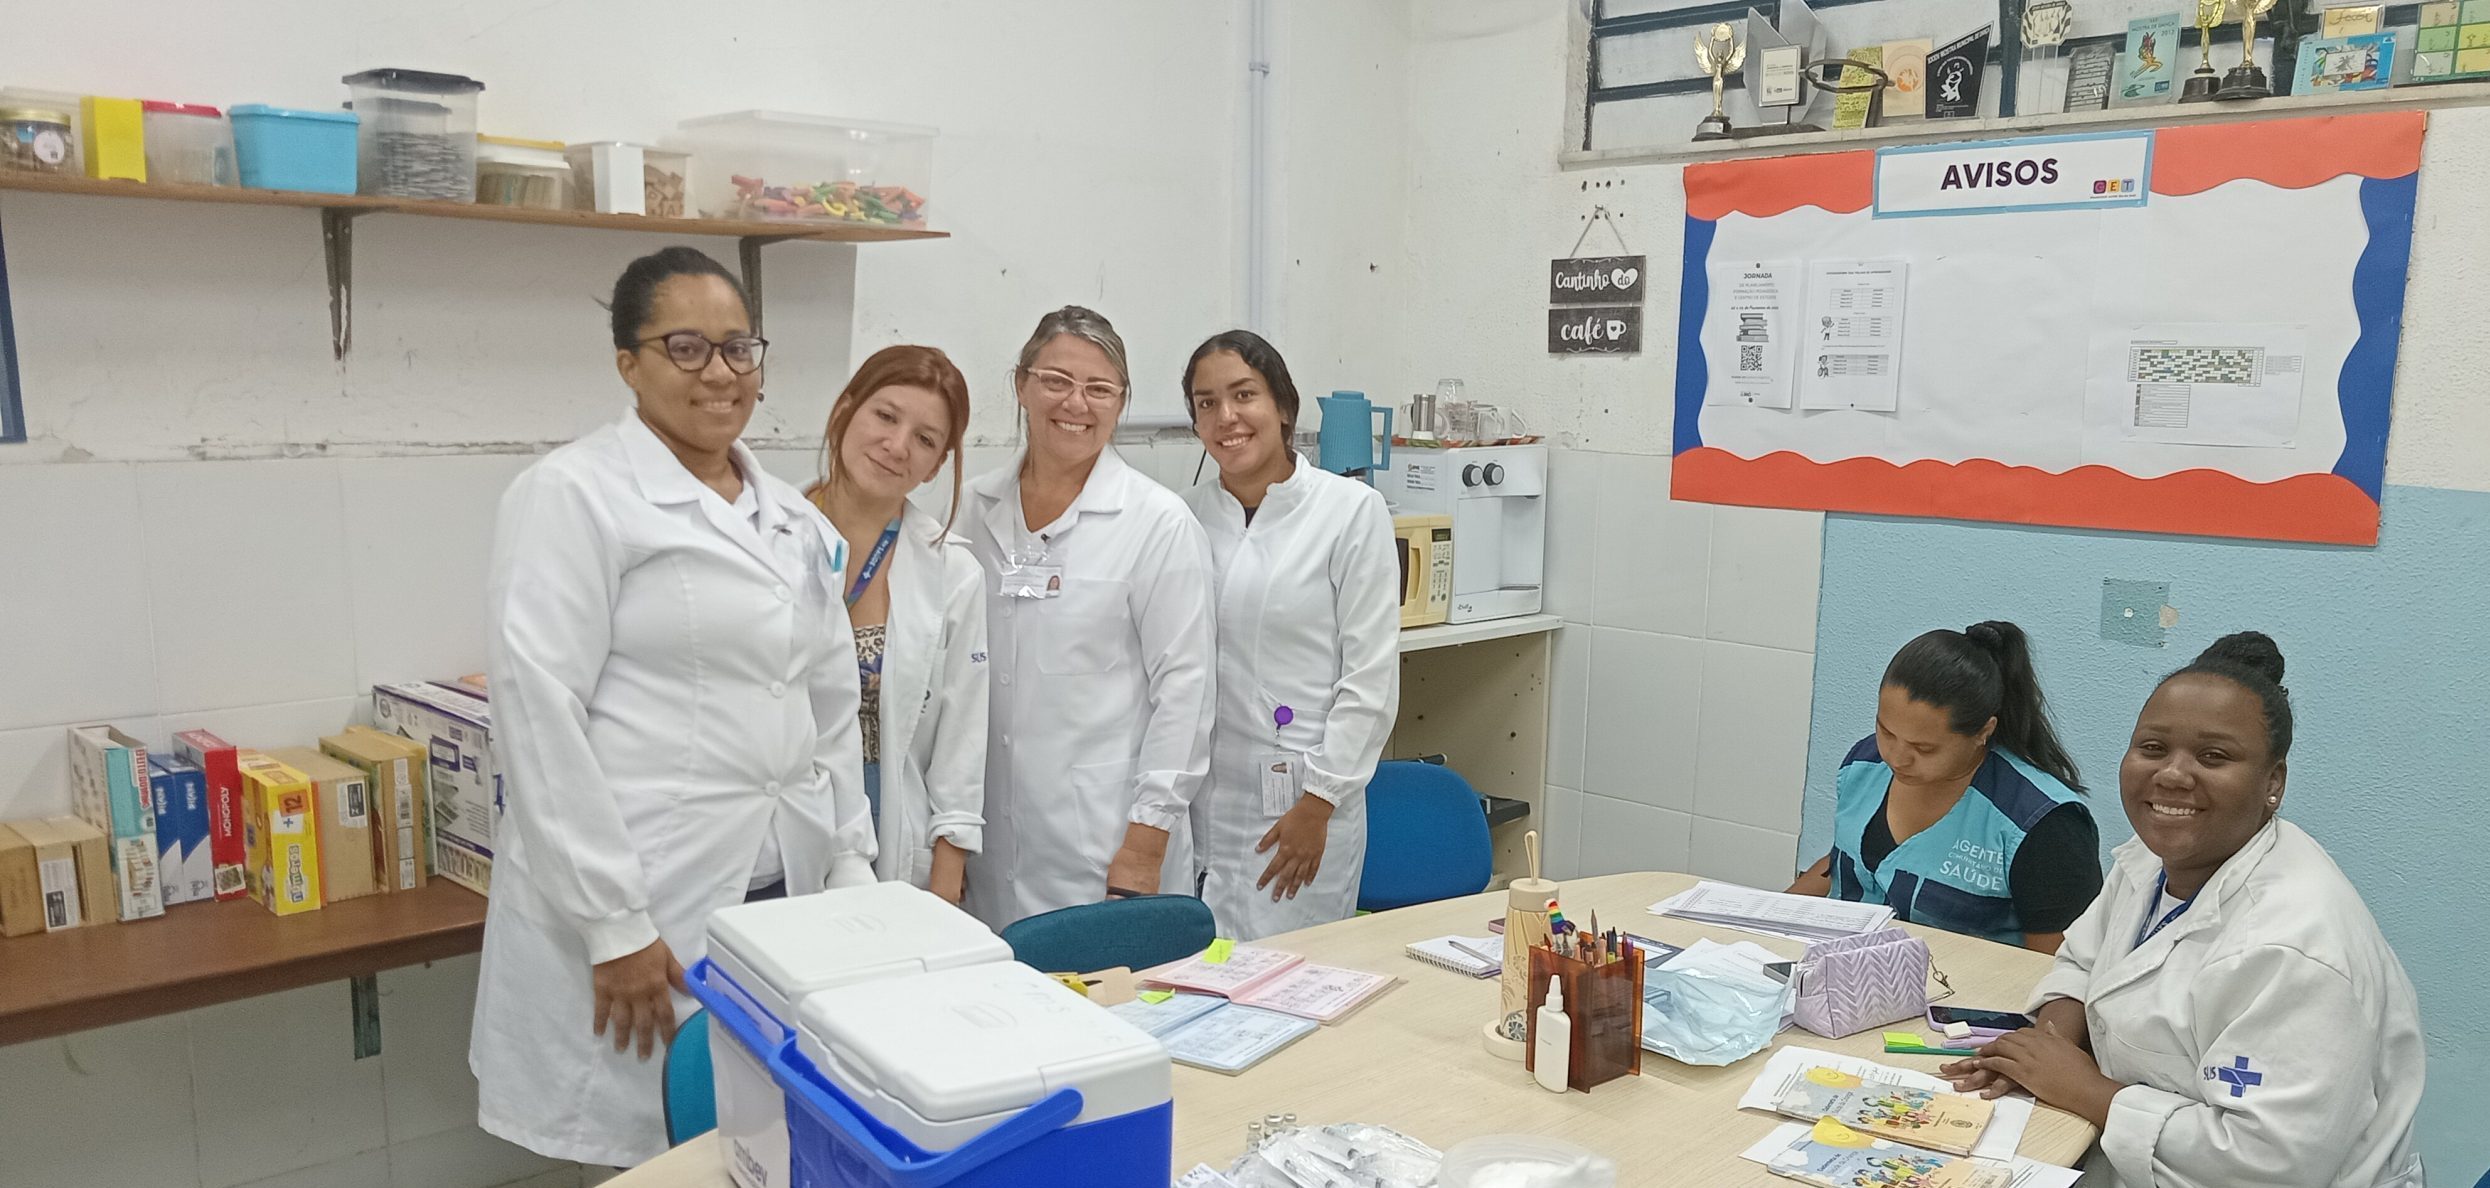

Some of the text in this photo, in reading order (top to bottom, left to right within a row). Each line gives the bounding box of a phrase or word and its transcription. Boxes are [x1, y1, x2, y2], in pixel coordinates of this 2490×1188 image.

[1940, 158, 2059, 191] AVISOS
[1555, 268, 1611, 292] Cantinho
[1743, 272, 1773, 280] JORNADA
[1560, 316, 1605, 346] café
[971, 652, 987, 663] SUS
[220, 786, 232, 837] MONOPOLY
[1952, 839, 2004, 866] AGENTE
[1939, 860, 2003, 891] SAÚDE
[2203, 1066, 2217, 1081] SUS
